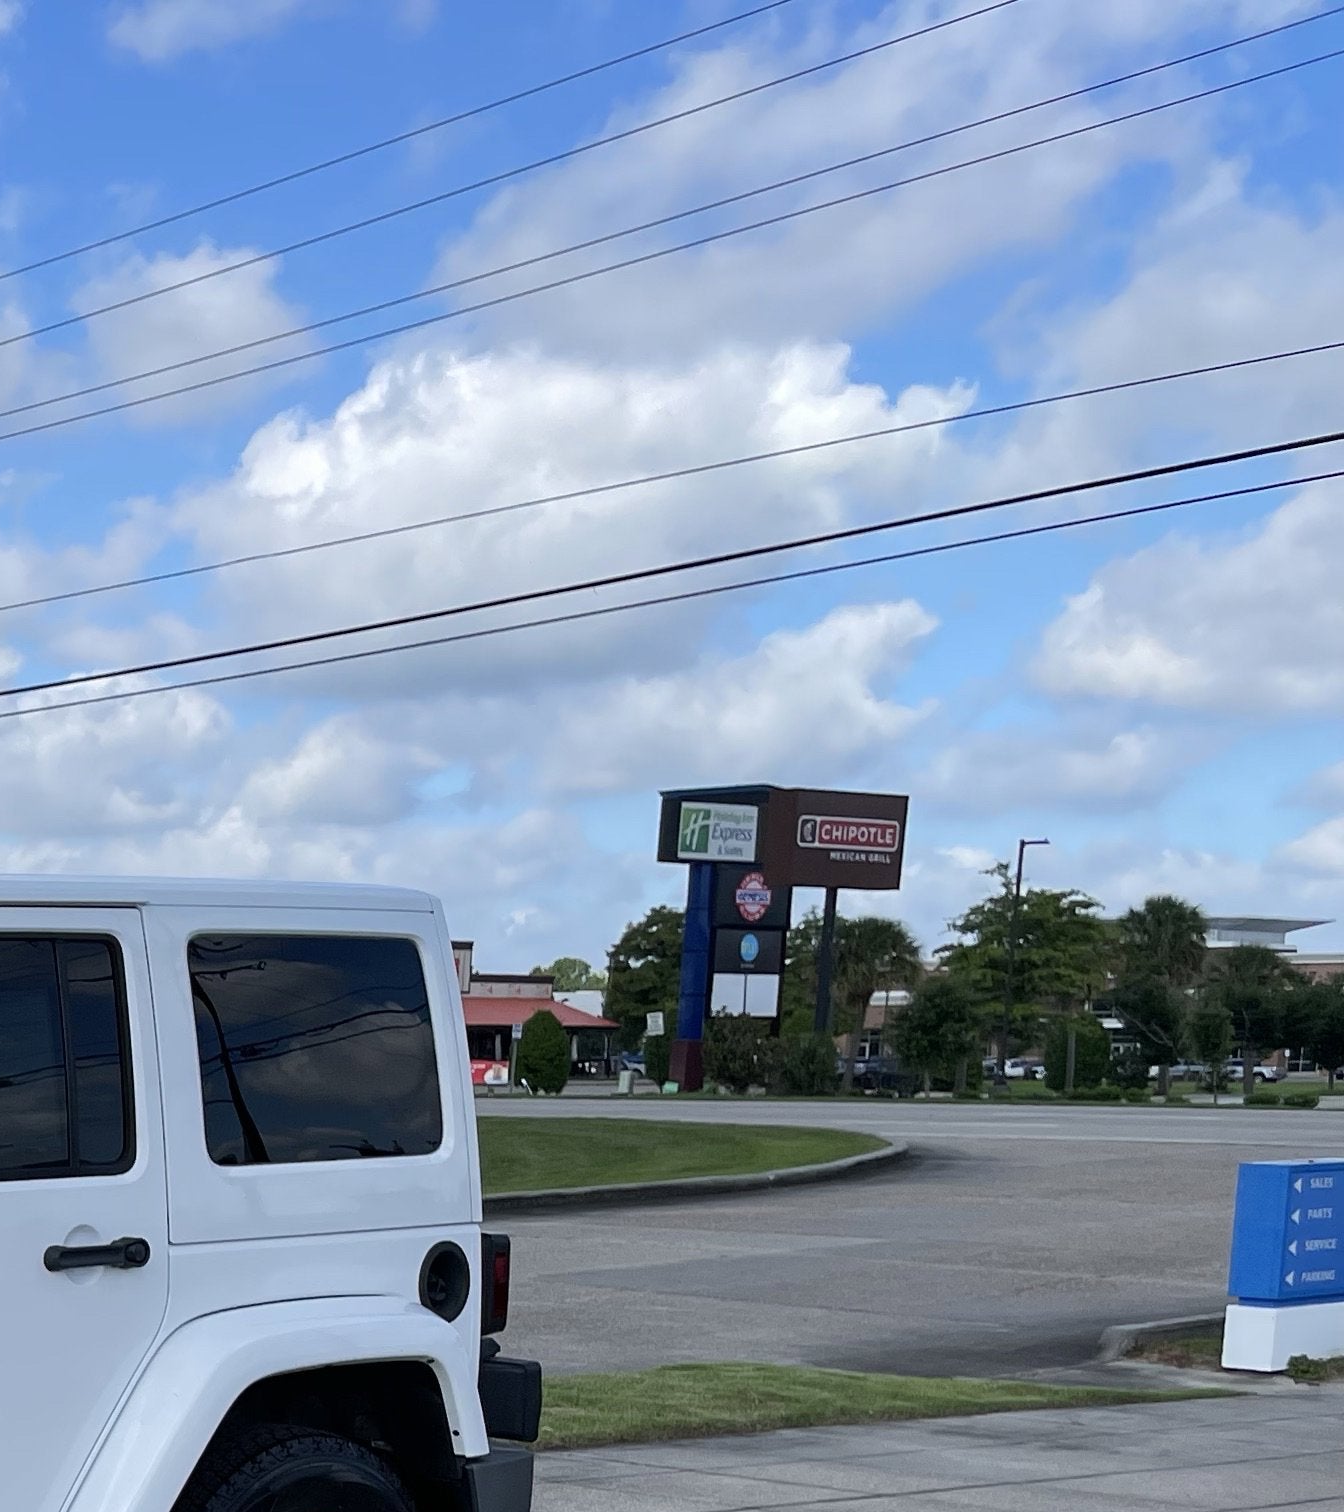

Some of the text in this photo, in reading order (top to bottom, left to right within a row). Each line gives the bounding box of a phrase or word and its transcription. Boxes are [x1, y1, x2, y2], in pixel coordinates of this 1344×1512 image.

[712, 823, 752, 845] Express
[820, 823, 894, 845] CHIPOTLE
[1310, 1177, 1333, 1189] SALES
[1308, 1208, 1332, 1220] PARTS
[1305, 1239, 1337, 1252] SERVICE
[1302, 1270, 1336, 1283] PARKING
